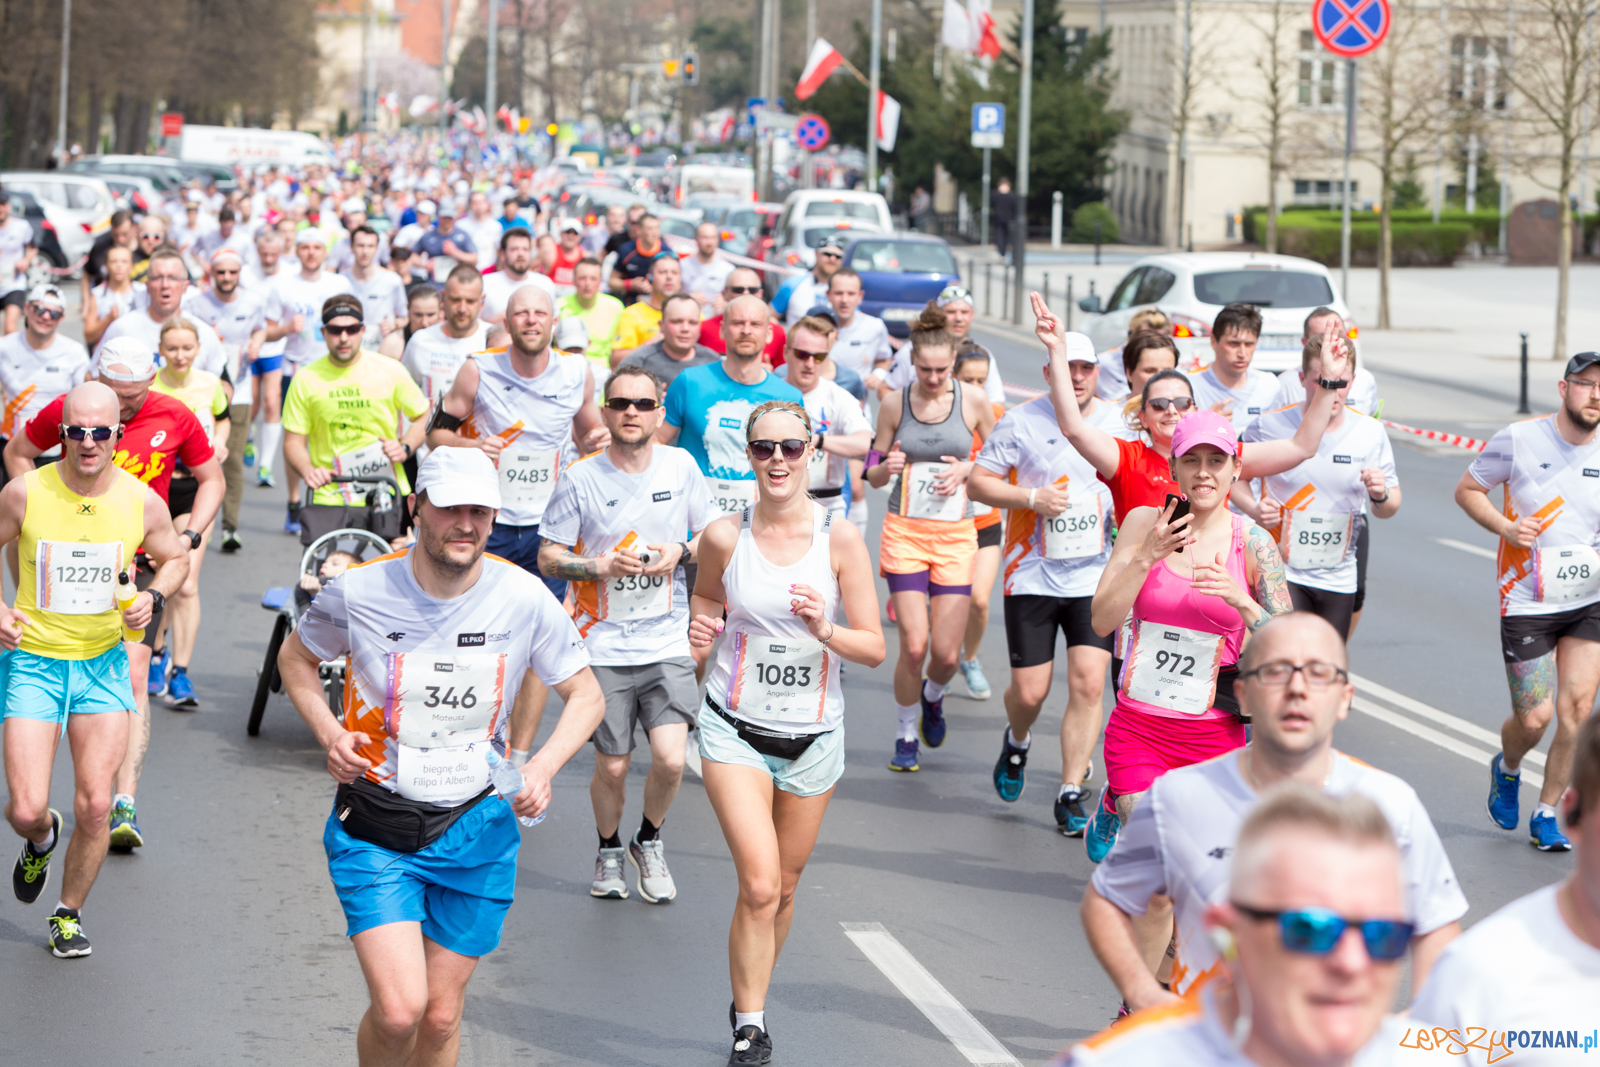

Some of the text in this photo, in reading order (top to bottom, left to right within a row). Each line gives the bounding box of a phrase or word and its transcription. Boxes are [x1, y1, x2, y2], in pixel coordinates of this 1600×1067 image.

[979, 107, 999, 130] P
[506, 468, 549, 483] 9483
[606, 499, 619, 507] 4F
[1047, 514, 1098, 533] 10369
[1298, 530, 1343, 546] 8593
[56, 566, 112, 583] 12278
[1556, 563, 1591, 581] 498
[386, 631, 406, 642] 4F
[461, 636, 484, 644] 11.PKO
[1155, 649, 1196, 678] 972
[756, 662, 811, 687] 1083
[1158, 676, 1184, 687] Joanna
[424, 686, 477, 709] 346
[766, 690, 796, 698] Angelika
[432, 714, 466, 722] Mateusz
[423, 763, 468, 775] biegnę dla
[413, 777, 437, 788] Filipa
[445, 775, 475, 786] Alberta
